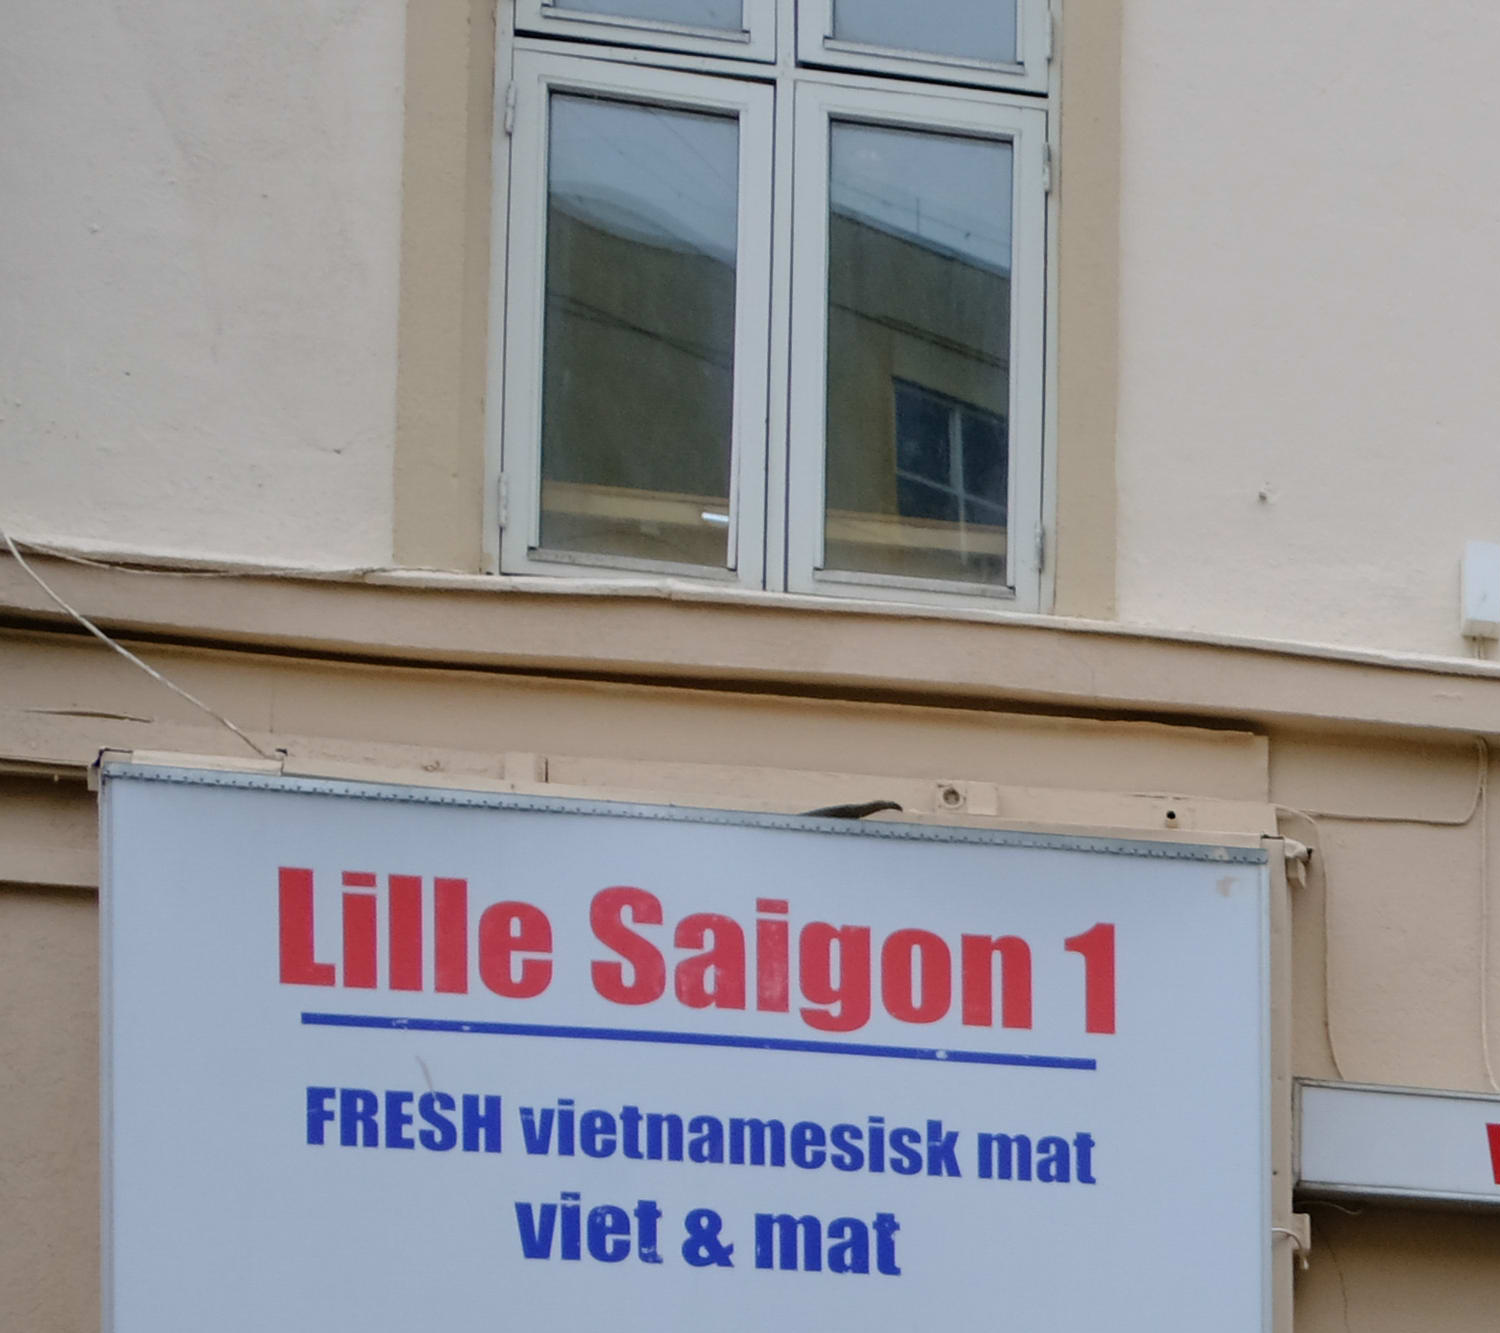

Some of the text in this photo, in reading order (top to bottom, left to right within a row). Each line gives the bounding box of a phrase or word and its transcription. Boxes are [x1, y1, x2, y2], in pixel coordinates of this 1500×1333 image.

[278, 866, 1117, 1036] Lille Saigon 1
[305, 1085, 1097, 1186] FRESH vietnamesisk mat
[514, 1192, 904, 1278] viet & mat
